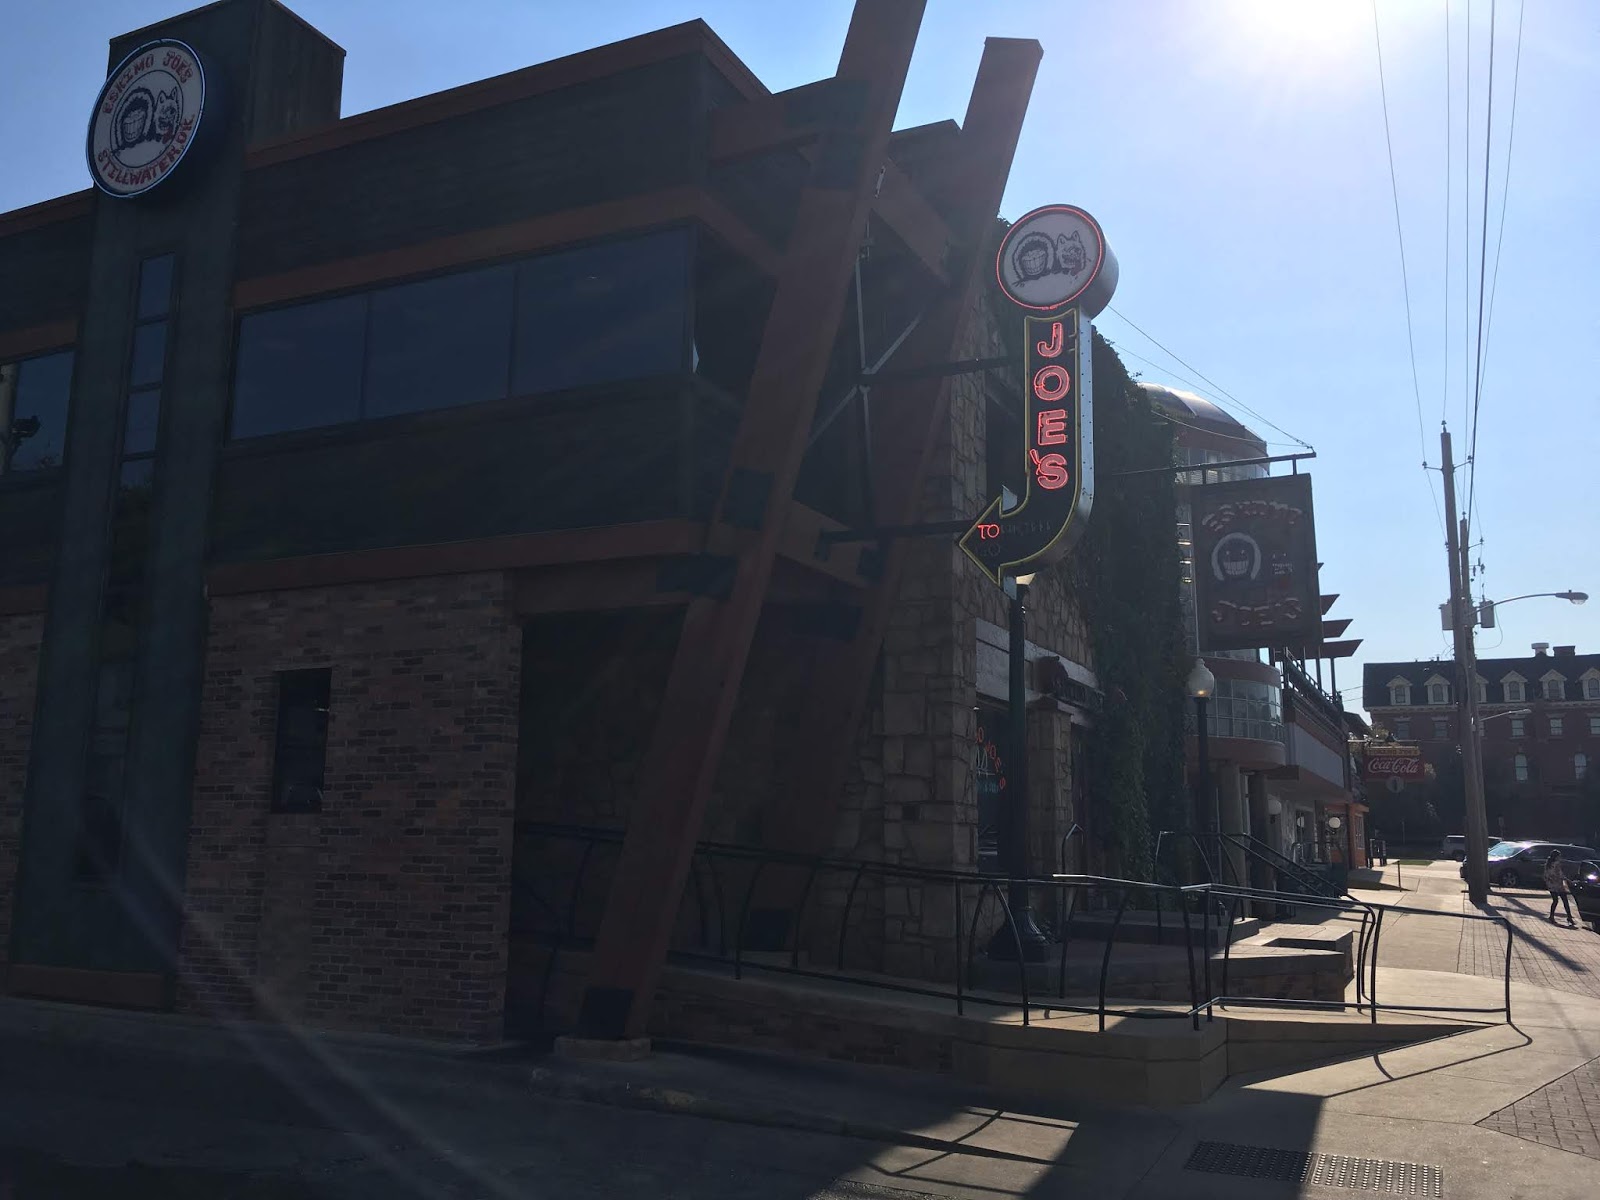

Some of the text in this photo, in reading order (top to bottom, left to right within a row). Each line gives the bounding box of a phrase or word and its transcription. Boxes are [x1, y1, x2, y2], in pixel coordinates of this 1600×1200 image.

[102, 53, 155, 114] ESKIMO
[1029, 321, 1071, 491] JOE'S
[976, 523, 1000, 540] TO
